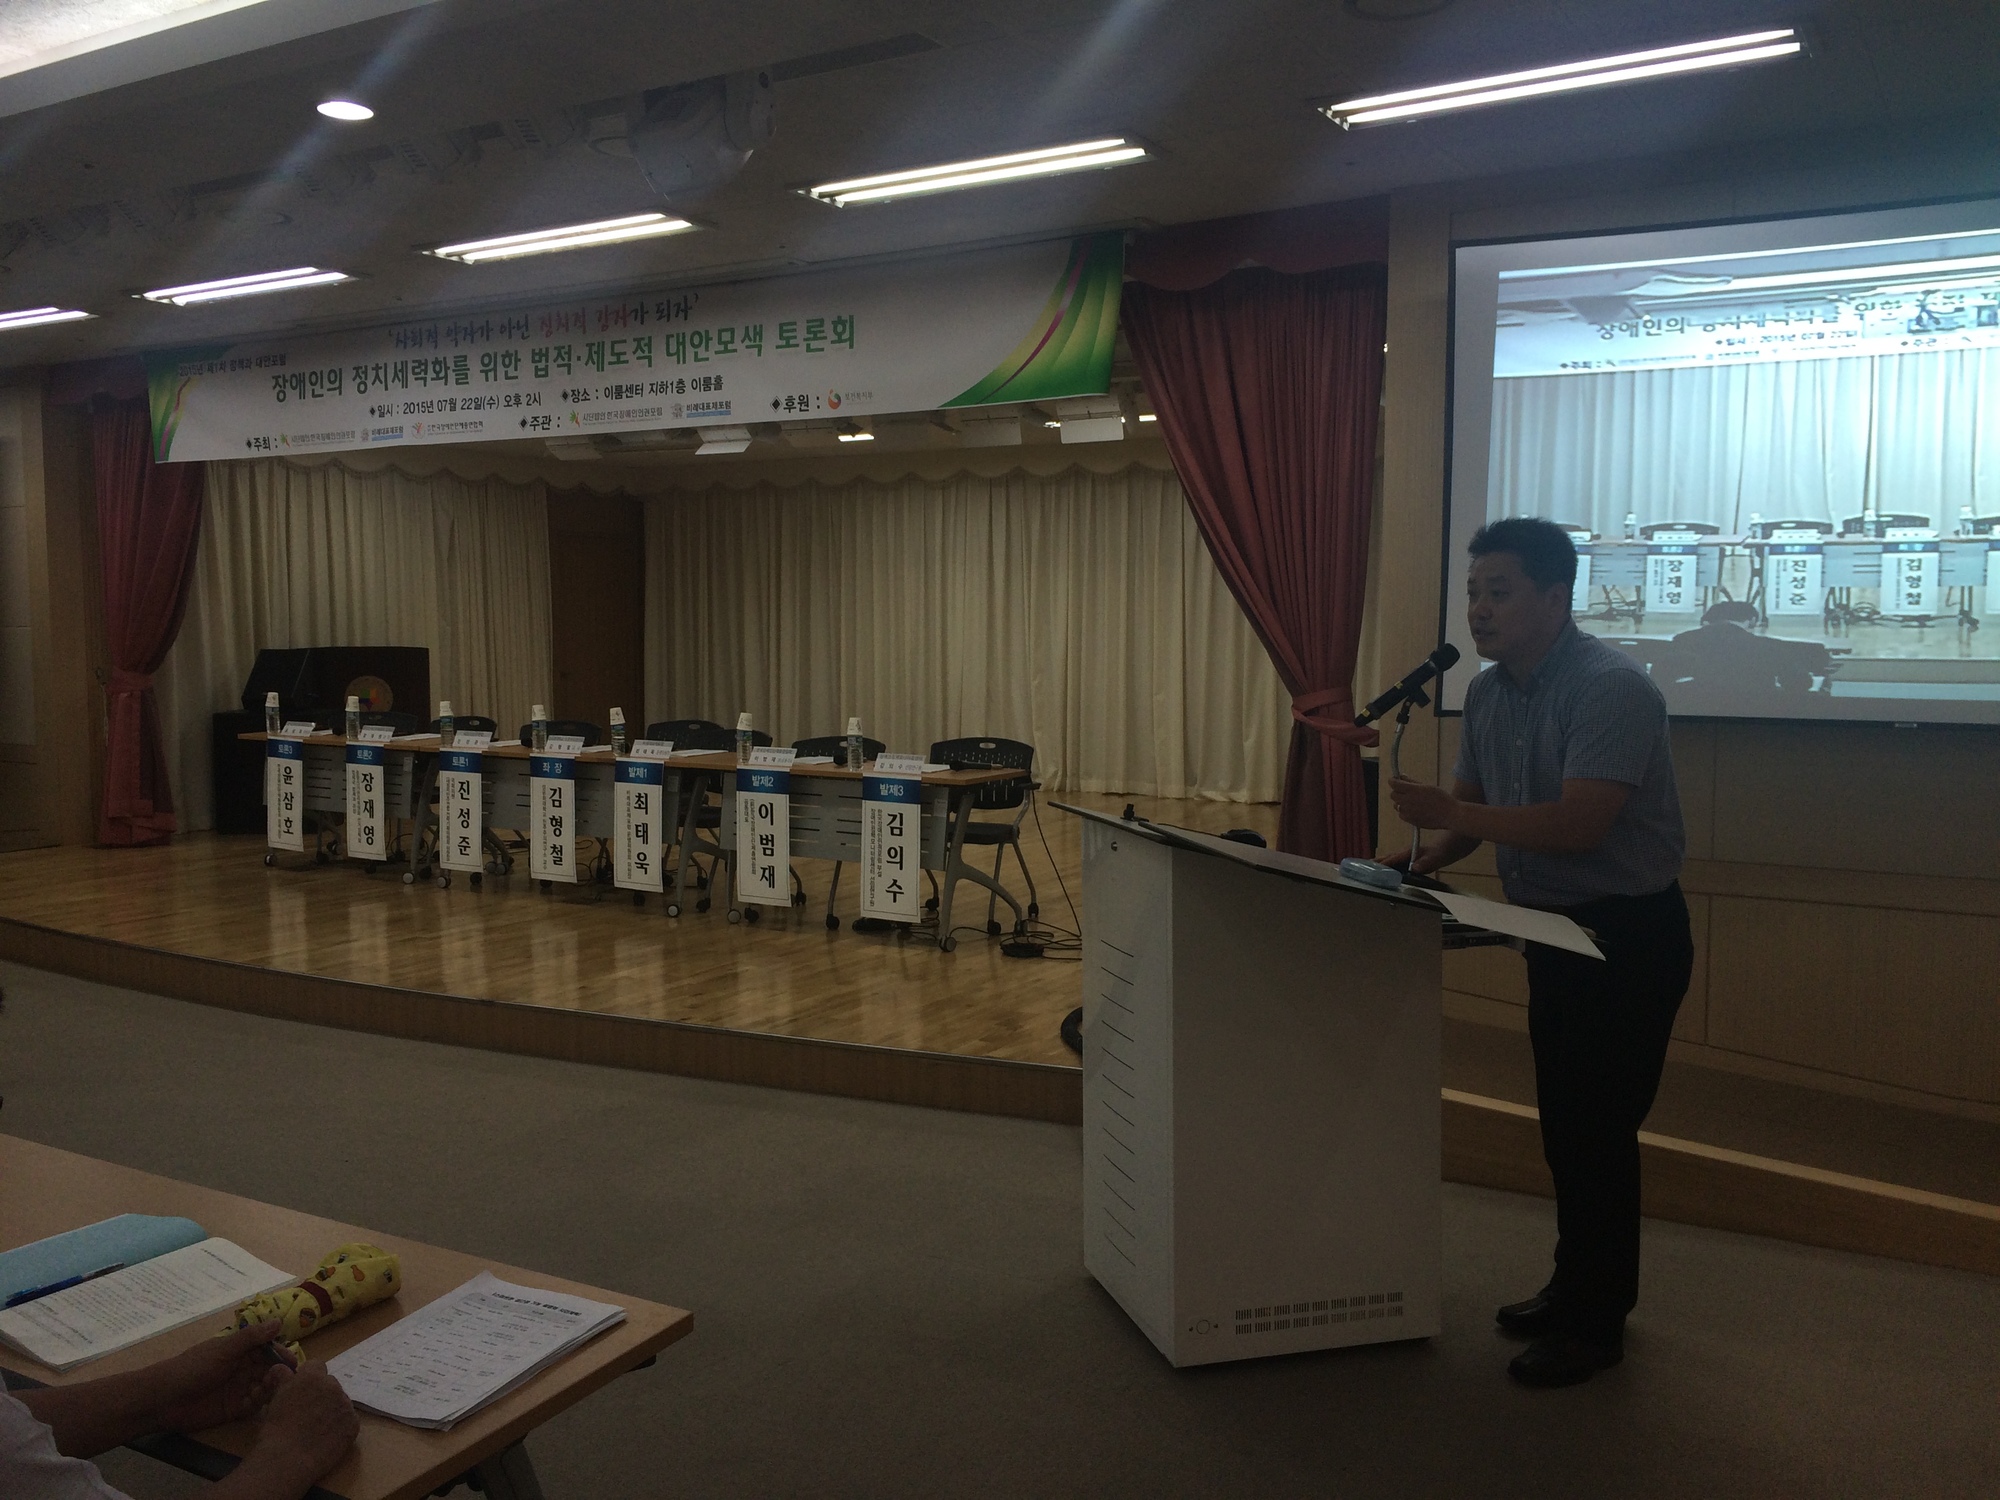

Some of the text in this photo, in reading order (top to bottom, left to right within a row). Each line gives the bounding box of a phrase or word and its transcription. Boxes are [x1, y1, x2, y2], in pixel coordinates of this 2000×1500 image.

[499, 313, 529, 340] 아닌
[271, 367, 343, 402] 장애인의
[352, 354, 470, 394] 정치세력화를
[480, 349, 521, 382] 위한
[665, 324, 764, 364] 대안모색
[775, 315, 855, 353] 토론회
[377, 403, 393, 418] 일시
[403, 400, 434, 415] 2015년
[437, 397, 457, 412] 07월
[460, 395, 500, 412] 22일(수)
[503, 393, 522, 408] 오후
[526, 391, 542, 407] 2시
[570, 388, 591, 403] 장소
[604, 382, 644, 400] 이룸센터
[649, 379, 686, 396] 지하1층
[691, 374, 724, 393] 이룸홀
[783, 394, 810, 414] 후원
[530, 414, 551, 431] 주관
[254, 436, 271, 451] 주최
[277, 743, 294, 755] 토론3
[356, 749, 373, 761] 토론2
[452, 755, 469, 767] 토론1
[628, 766, 648, 779] 발제1
[751, 774, 774, 787] 발제2
[282, 765, 295, 835] 윤삼호
[879, 783, 904, 797] 발제3
[361, 771, 375, 846] 장재영
[457, 779, 472, 856] 진성준
[549, 786, 563, 867] 김형철
[633, 792, 650, 876] 최태욱
[757, 801, 775, 889] 이범재
[885, 812, 906, 904] 김의수
